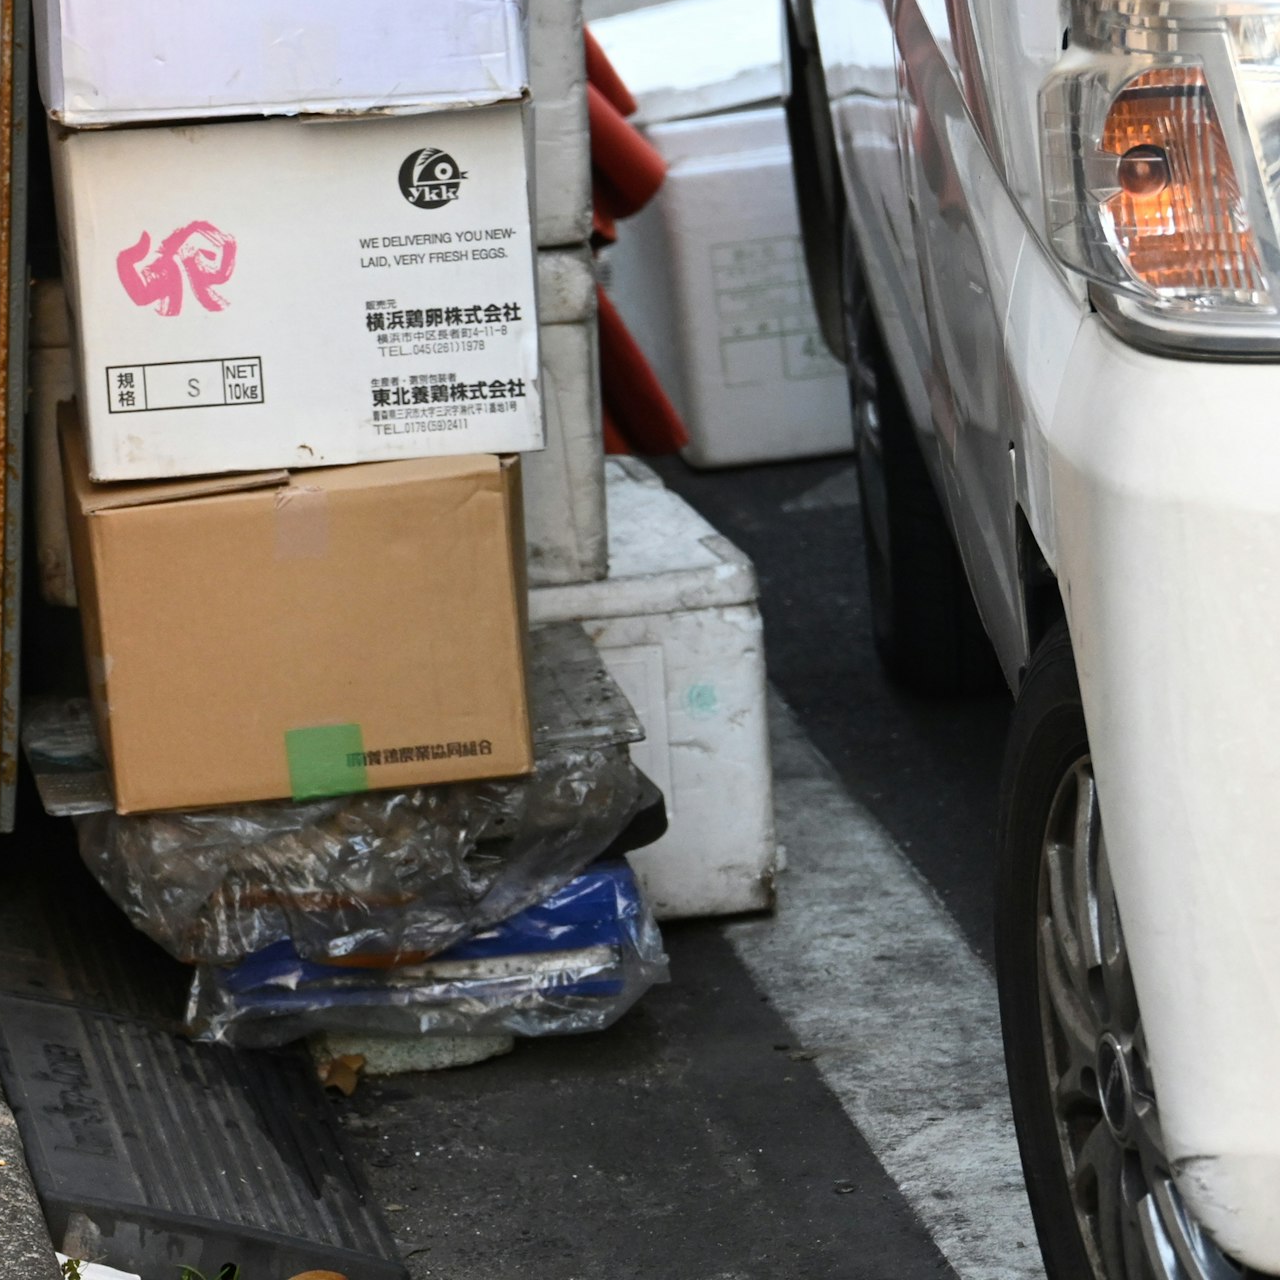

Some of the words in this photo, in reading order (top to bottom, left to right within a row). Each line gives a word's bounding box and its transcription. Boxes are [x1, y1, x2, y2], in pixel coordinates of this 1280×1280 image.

[408, 186, 459, 203] ykk
[359, 237, 380, 249] WE
[382, 232, 452, 248] DELIVERING
[455, 230, 483, 243] YOU
[485, 228, 517, 241] NEW-
[360, 256, 391, 269] LAID,
[393, 253, 426, 266] VERY
[429, 250, 469, 264] FRESH
[471, 247, 509, 261] EGGS.
[365, 302, 522, 332] 横浜鶏卵株式会社
[225, 363, 259, 380] NET
[116, 372, 137, 408] 規格
[187, 377, 201, 398] S
[228, 383, 259, 401] 10kg
[371, 378, 527, 407] 東北養鶏株式会社
